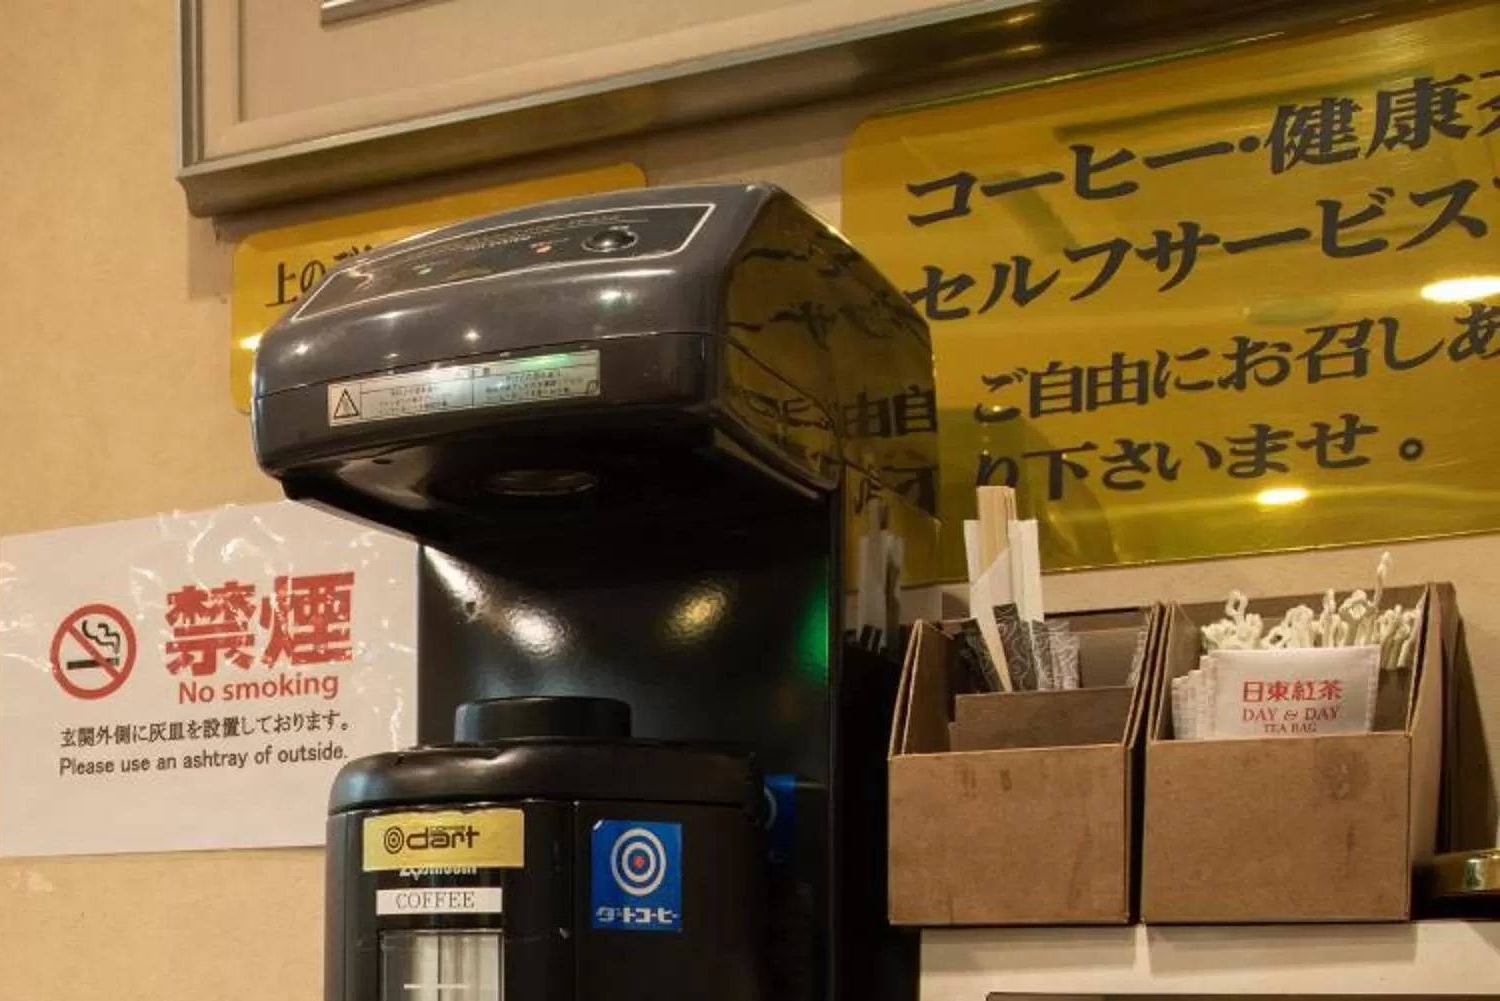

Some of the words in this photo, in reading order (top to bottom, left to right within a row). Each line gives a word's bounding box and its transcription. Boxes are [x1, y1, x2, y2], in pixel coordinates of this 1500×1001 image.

[907, 70, 1500, 227] コーヒー・健康
[164, 571, 355, 677] 禁煙
[179, 681, 215, 704] No
[222, 673, 340, 703] smoking
[1243, 680, 1343, 703] 日東紅茶
[60, 709, 348, 747] 玄関外側に灰皿を設置しております。
[1242, 707, 1278, 722] DAY
[1304, 706, 1341, 721] DAY
[1264, 723, 1287, 734] TEA
[1290, 722, 1317, 733] BAG
[59, 757, 115, 776] Please
[121, 755, 150, 771] use
[157, 754, 177, 770] an
[183, 748, 248, 769] ashtray
[255, 744, 273, 764] of
[277, 741, 348, 763] outside.
[407, 825, 480, 850] dart
[395, 890, 476, 910] COFFEE
